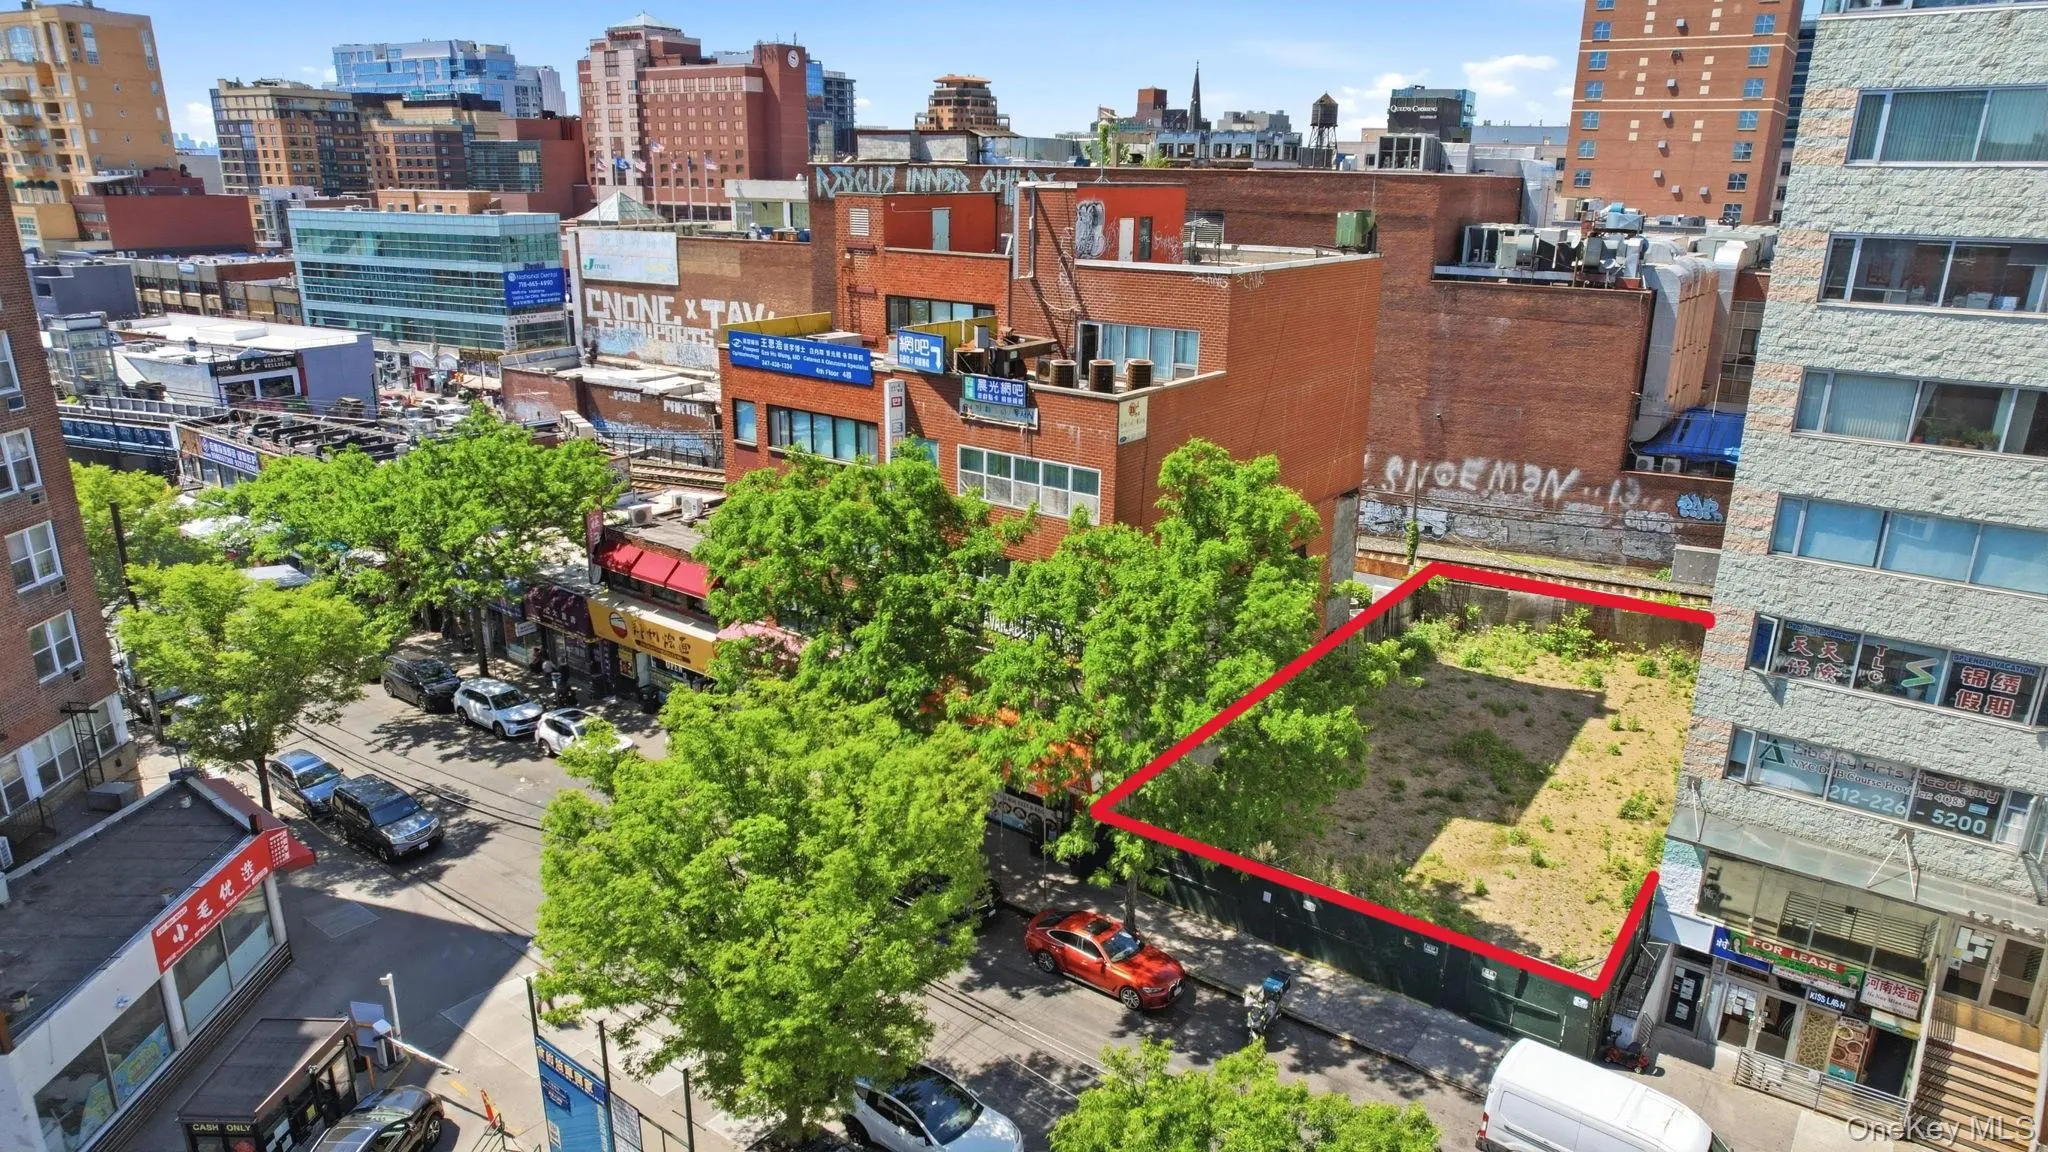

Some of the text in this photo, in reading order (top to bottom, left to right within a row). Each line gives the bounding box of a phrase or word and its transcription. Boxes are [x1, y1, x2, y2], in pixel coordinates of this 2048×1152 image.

[899, 335, 930, 357] 網吧
[825, 369, 839, 377] Floor
[977, 378, 1024, 397] 晨光網吧
[1788, 635, 1844, 663] 天天
[1953, 653, 2036, 675] SPLENDID VACATION
[1961, 666, 2022, 695] 锦绣
[1954, 688, 2015, 718] 假期
[1790, 757, 1816, 774] NYC
[1846, 770, 1882, 788] Course
[1863, 760, 1905, 779] Arts
[1911, 767, 2001, 805] Academy
[1829, 785, 1906, 816] 212-226
[1931, 809, 1987, 835] 5200
[1752, 939, 1783, 958] FOR
[1790, 951, 1839, 973] LEASE
[1809, 991, 1826, 1003] KISS
[192, 1123, 251, 1132] CASH ONLY
